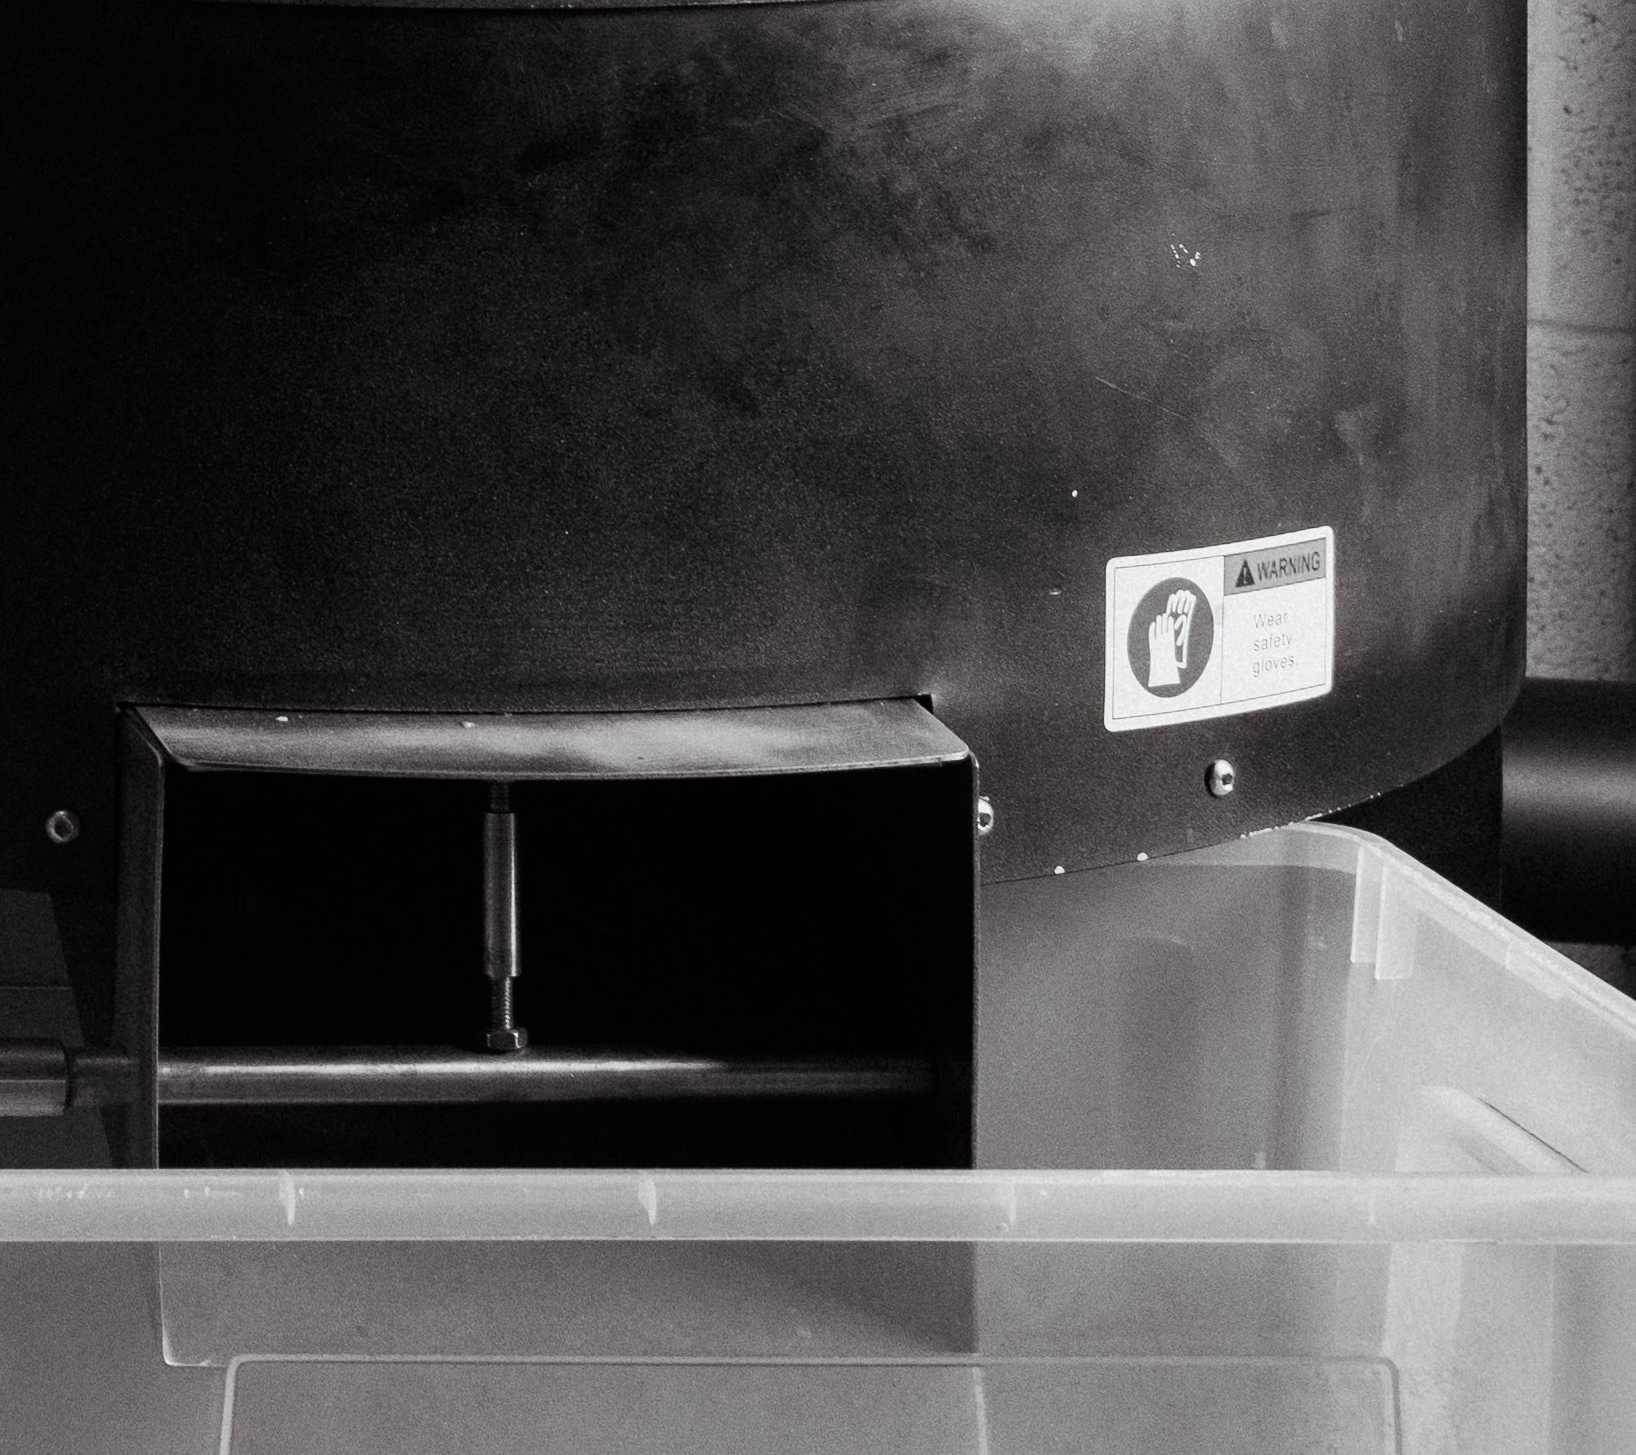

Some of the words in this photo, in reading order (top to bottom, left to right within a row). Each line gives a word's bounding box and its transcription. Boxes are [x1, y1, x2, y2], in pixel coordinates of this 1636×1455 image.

[1257, 551, 1321, 581] WARNING
[1253, 612, 1288, 629] Wear
[1253, 633, 1293, 652] safety
[1252, 655, 1298, 678] gloves.
